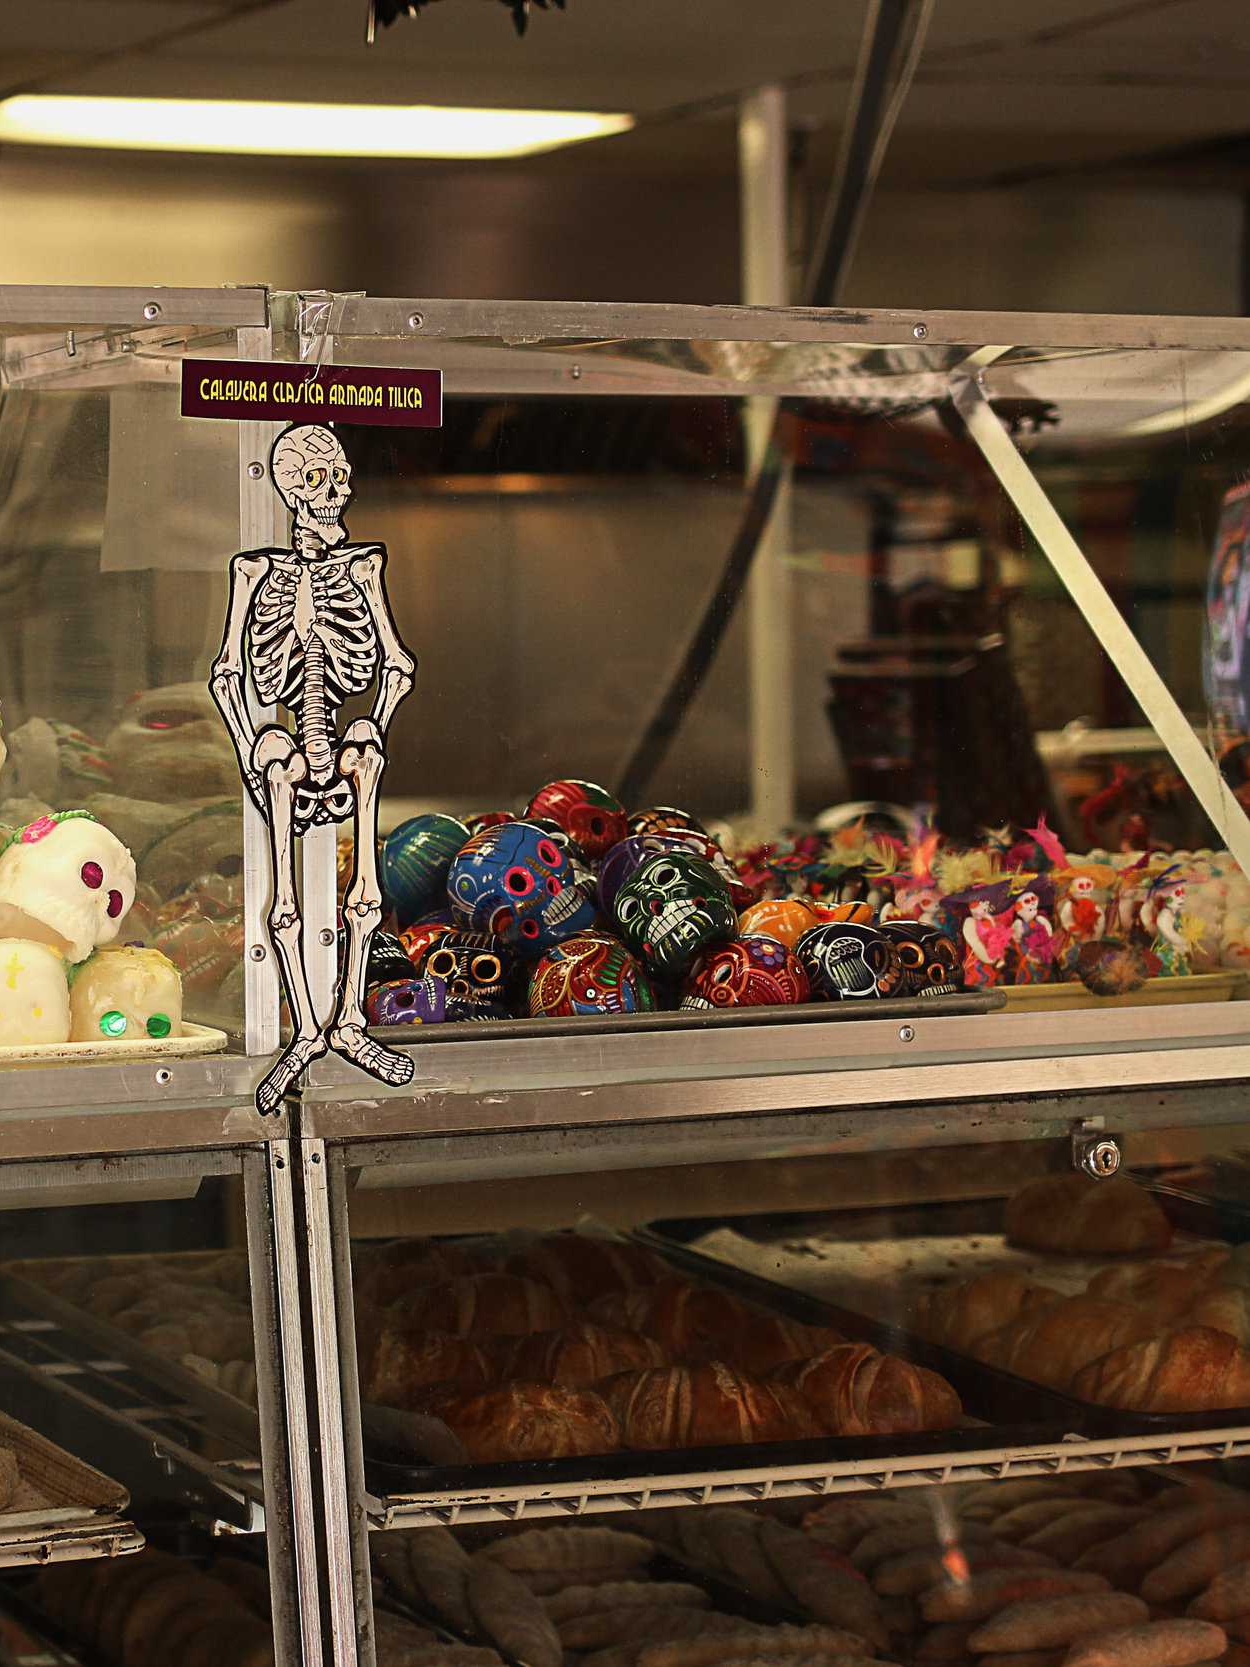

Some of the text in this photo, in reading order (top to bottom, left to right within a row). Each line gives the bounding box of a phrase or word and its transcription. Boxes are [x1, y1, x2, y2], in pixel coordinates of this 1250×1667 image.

[199, 378, 423, 409] CALAVERA CLASICA ARMADA TILICA
